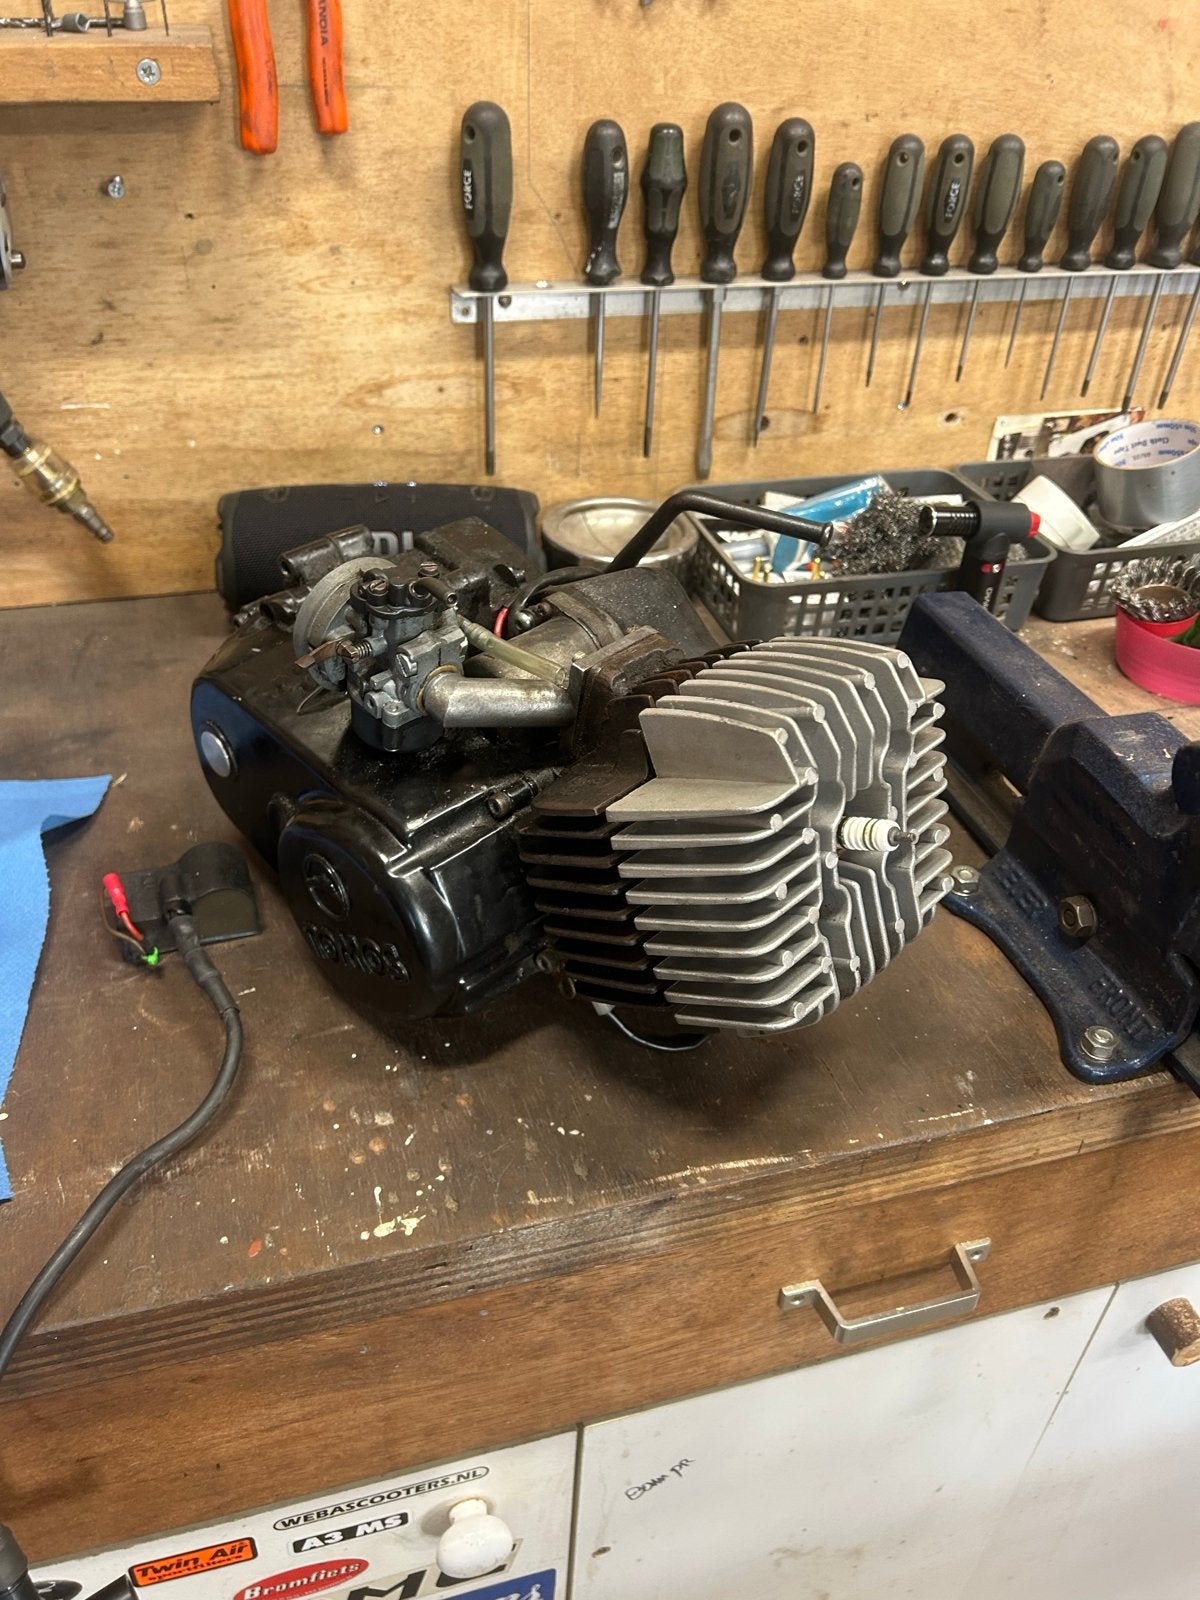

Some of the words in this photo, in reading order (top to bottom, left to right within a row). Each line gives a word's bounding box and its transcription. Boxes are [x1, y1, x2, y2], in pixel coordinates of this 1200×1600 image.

[462, 168, 473, 210] FORCE
[945, 179, 961, 219] FORCE
[281, 1469, 483, 1528] WEBASCOOTERS.NL
[301, 1531, 343, 1551] A3
[356, 1514, 402, 1537] MS
[137, 1555, 200, 1578] Twin
[209, 1541, 249, 1561] Air
[243, 1562, 361, 1600] Bromfiets
